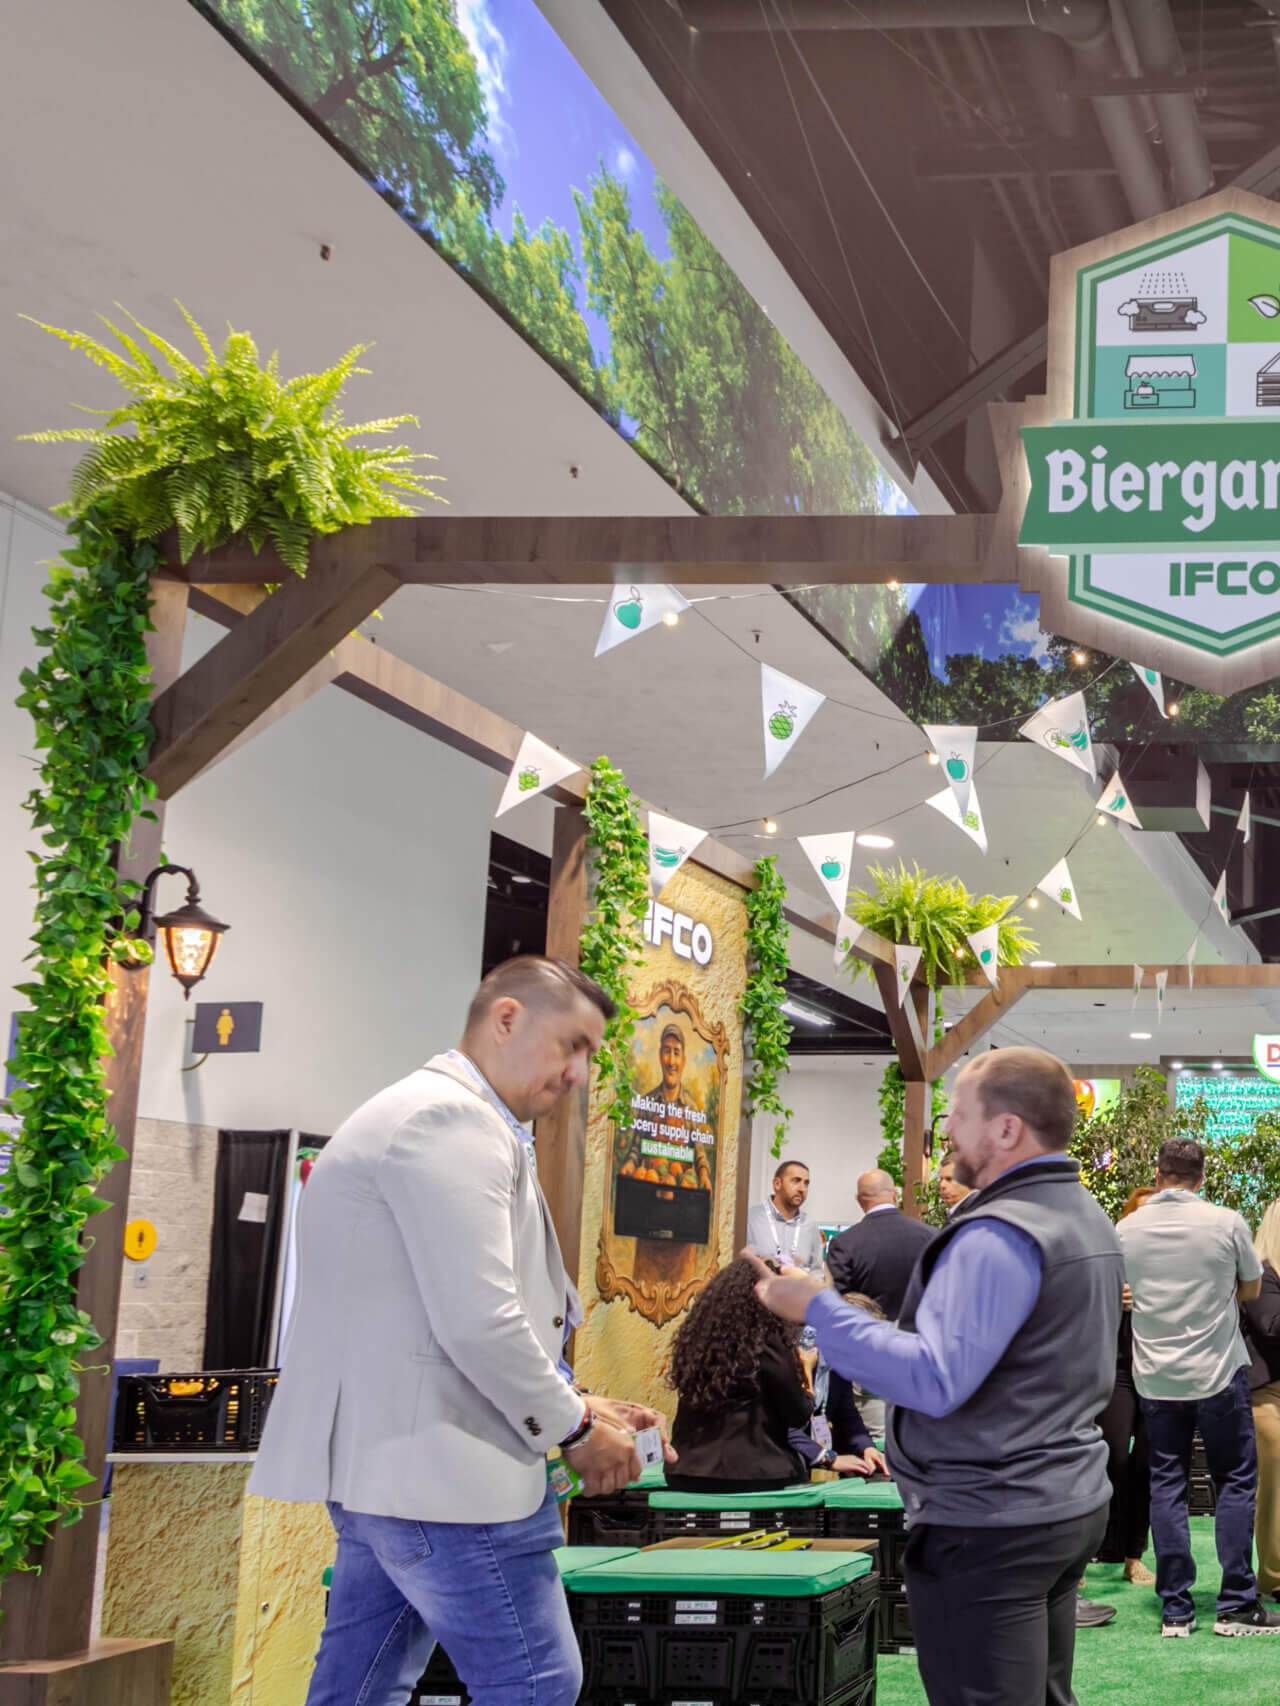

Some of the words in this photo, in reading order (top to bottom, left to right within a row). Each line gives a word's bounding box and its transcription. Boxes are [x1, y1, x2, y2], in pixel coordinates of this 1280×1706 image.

[643, 898, 713, 966] IFCO
[631, 1093, 666, 1118] Making
[667, 1102, 683, 1119] the
[685, 1106, 707, 1124] fresh
[620, 1115, 658, 1138] ocery
[658, 1123, 690, 1144] supply
[690, 1126, 715, 1145] chain
